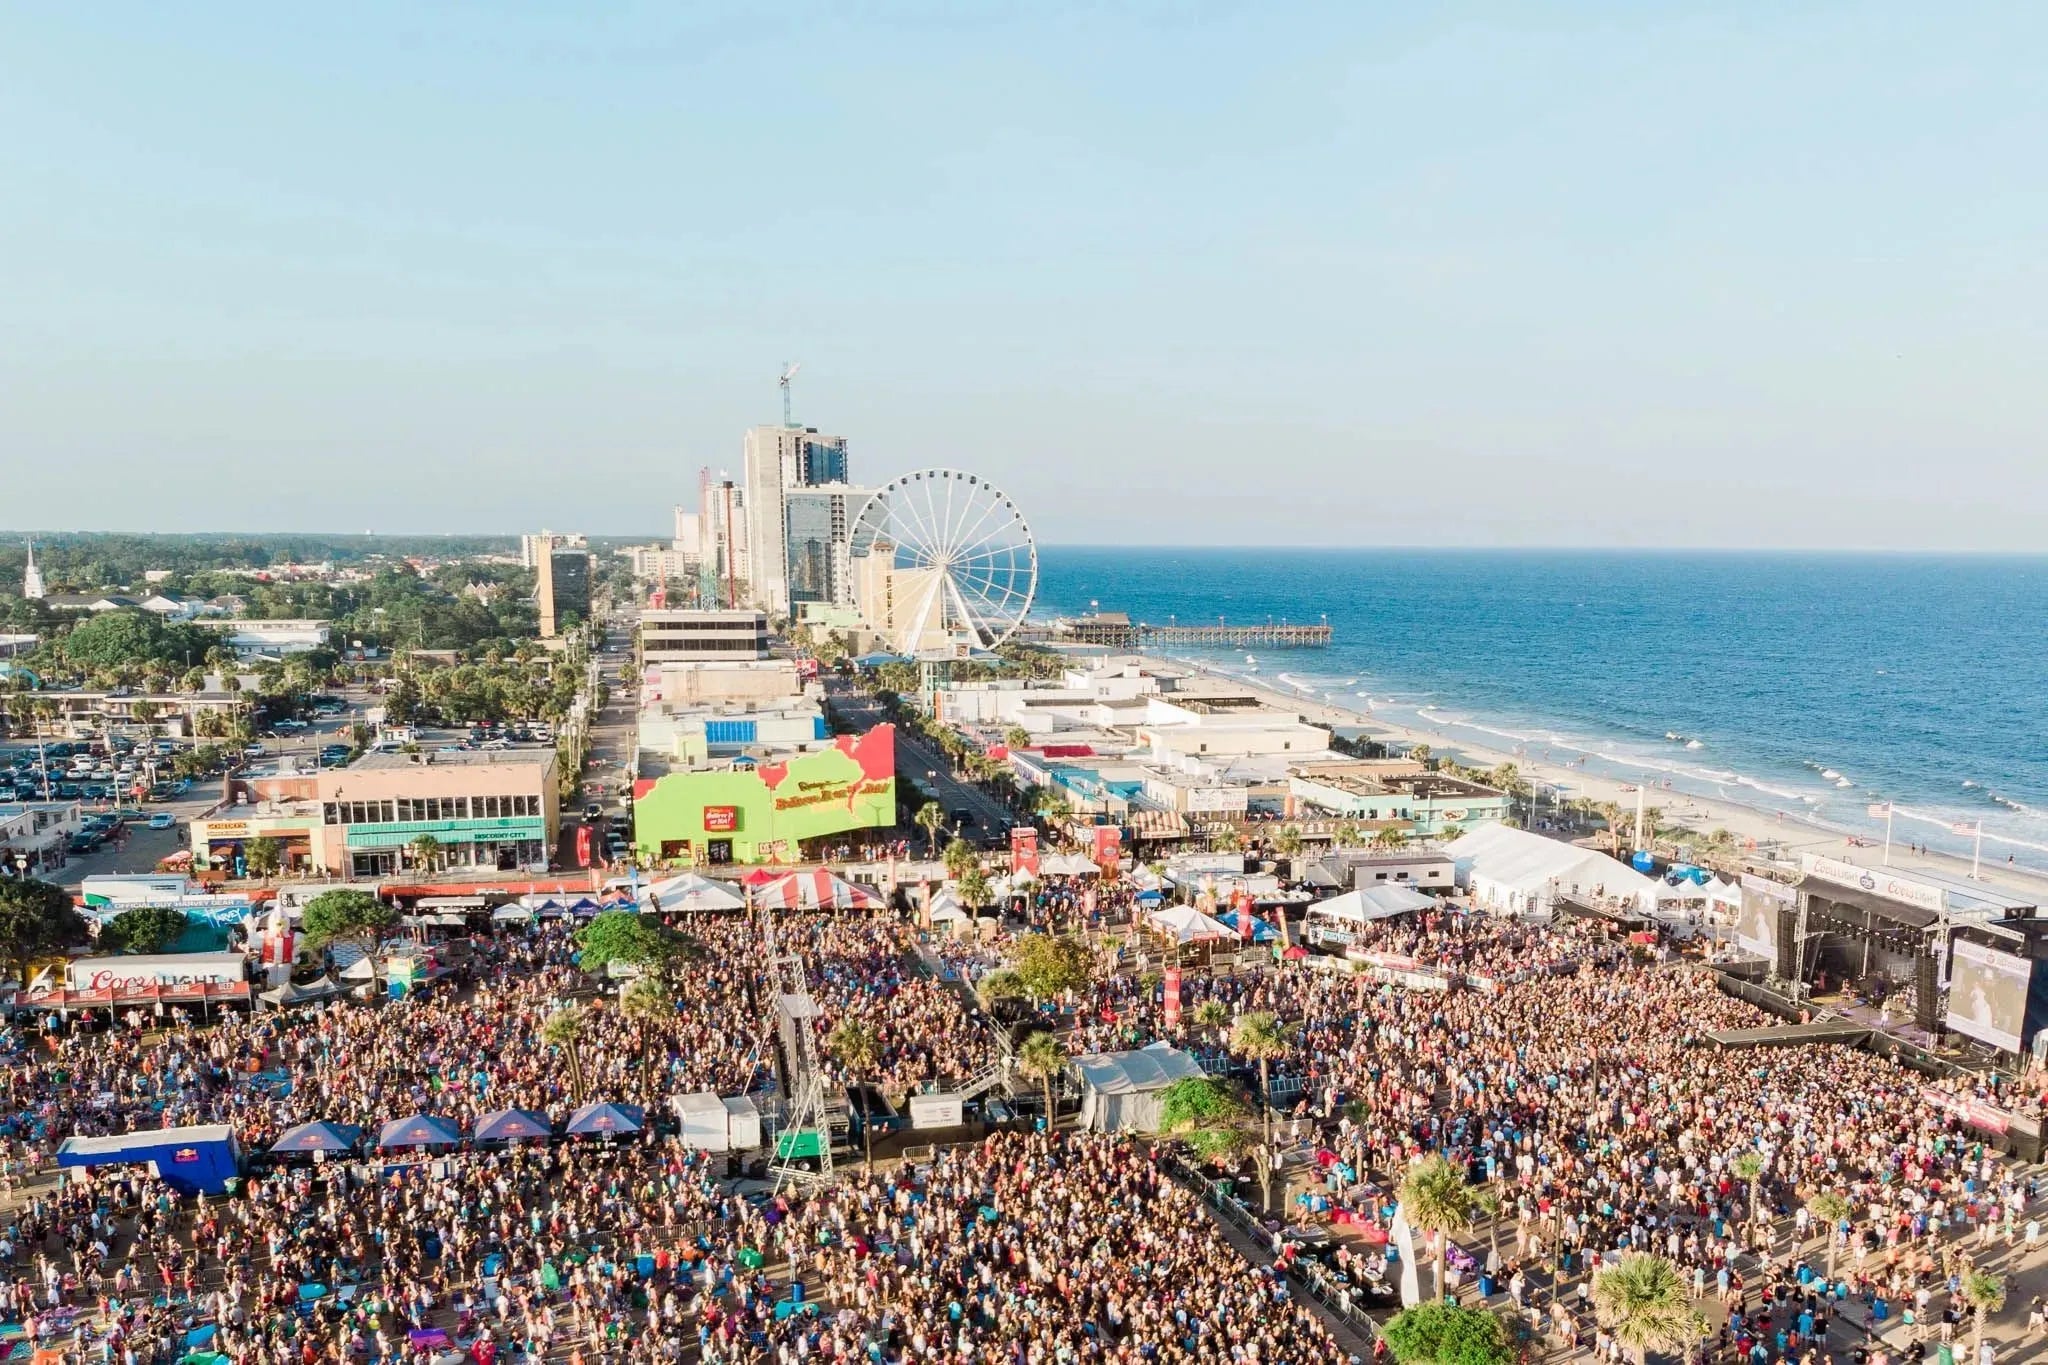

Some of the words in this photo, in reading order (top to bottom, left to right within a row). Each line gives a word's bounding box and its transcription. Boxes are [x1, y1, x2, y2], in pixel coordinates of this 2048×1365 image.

[173, 984, 190, 992] BEER
[218, 981, 235, 990] BEER
[79, 989, 97, 998] BEER
[126, 986, 144, 995] BEER
[32, 991, 50, 1000] BEER
